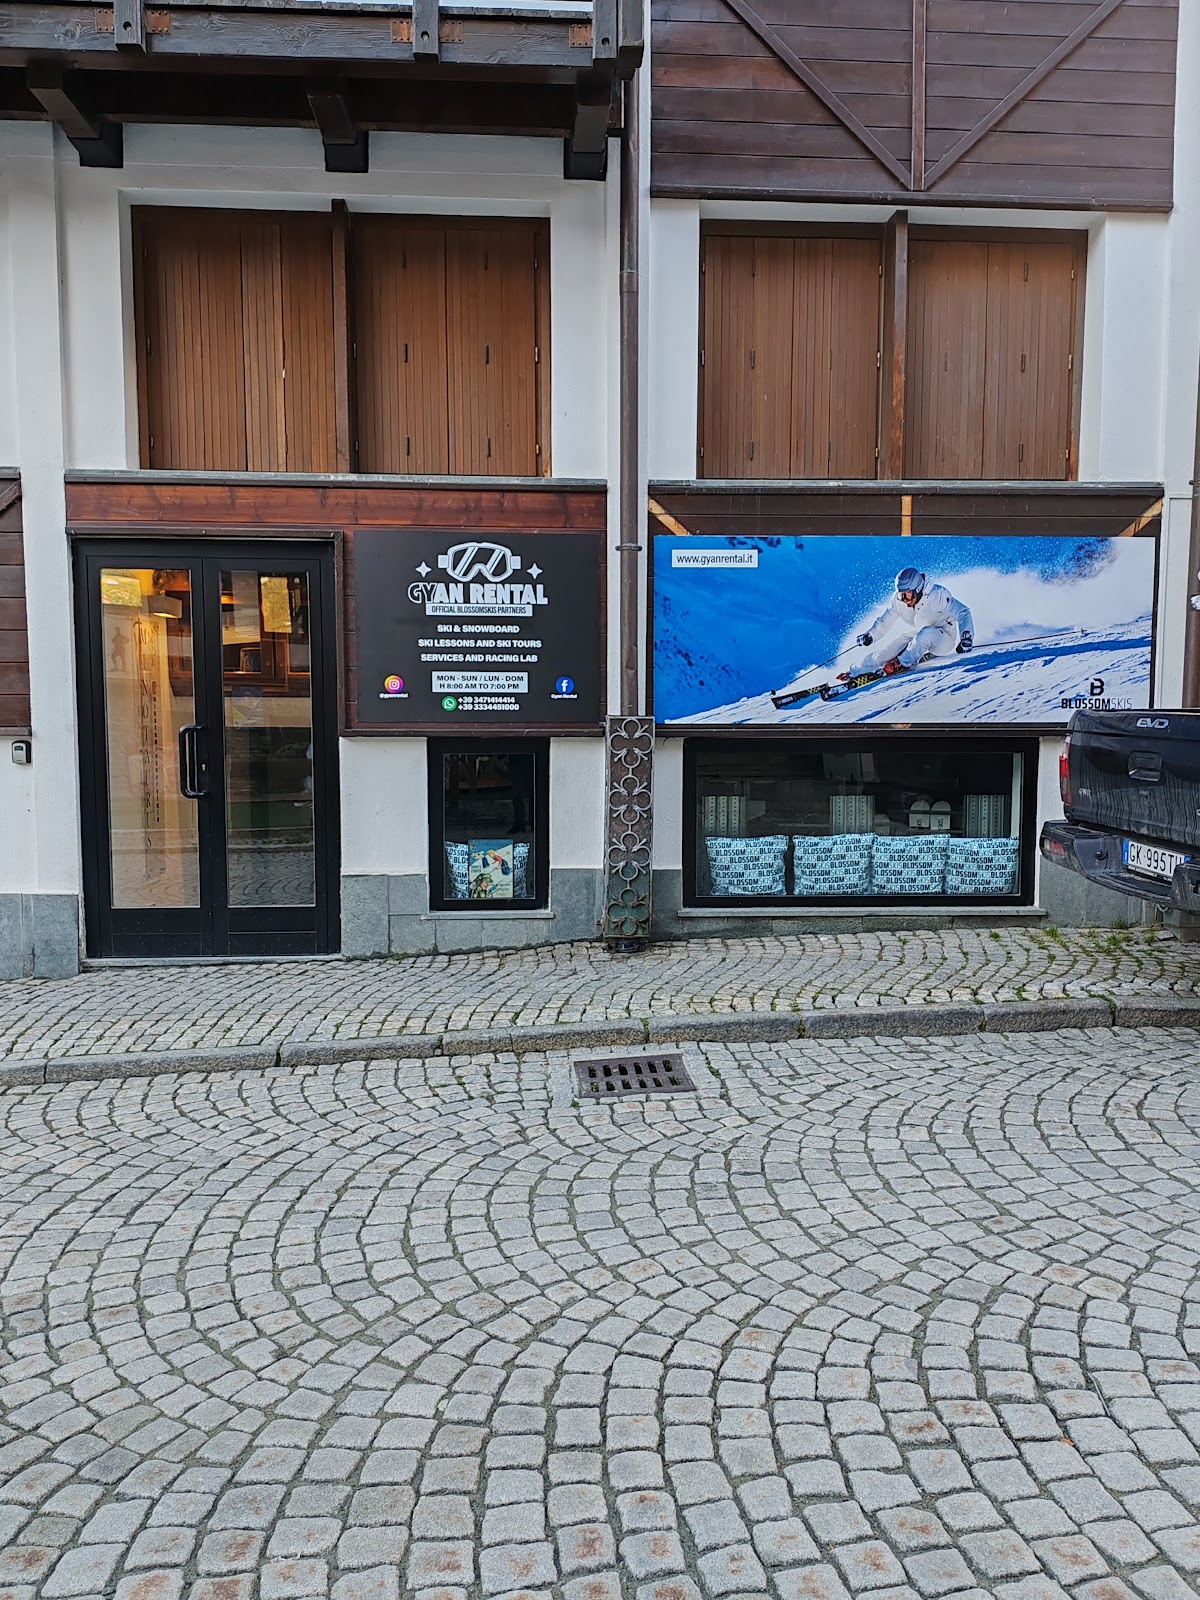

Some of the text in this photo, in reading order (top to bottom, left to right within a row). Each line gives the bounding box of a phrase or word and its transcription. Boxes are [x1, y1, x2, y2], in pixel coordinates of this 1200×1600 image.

[676, 554, 753, 566] www.gyanrental.it
[408, 582, 549, 605] GYAN RENTAL
[436, 624, 520, 634] SKI & SNOWBOARD
[418, 639, 542, 648] SKI LESSONS AND SKI TOURS
[420, 654, 538, 663] SERVICES AND RACING LAB
[1136, 718, 1170, 728] EVO
[1130, 844, 1142, 864] GK
